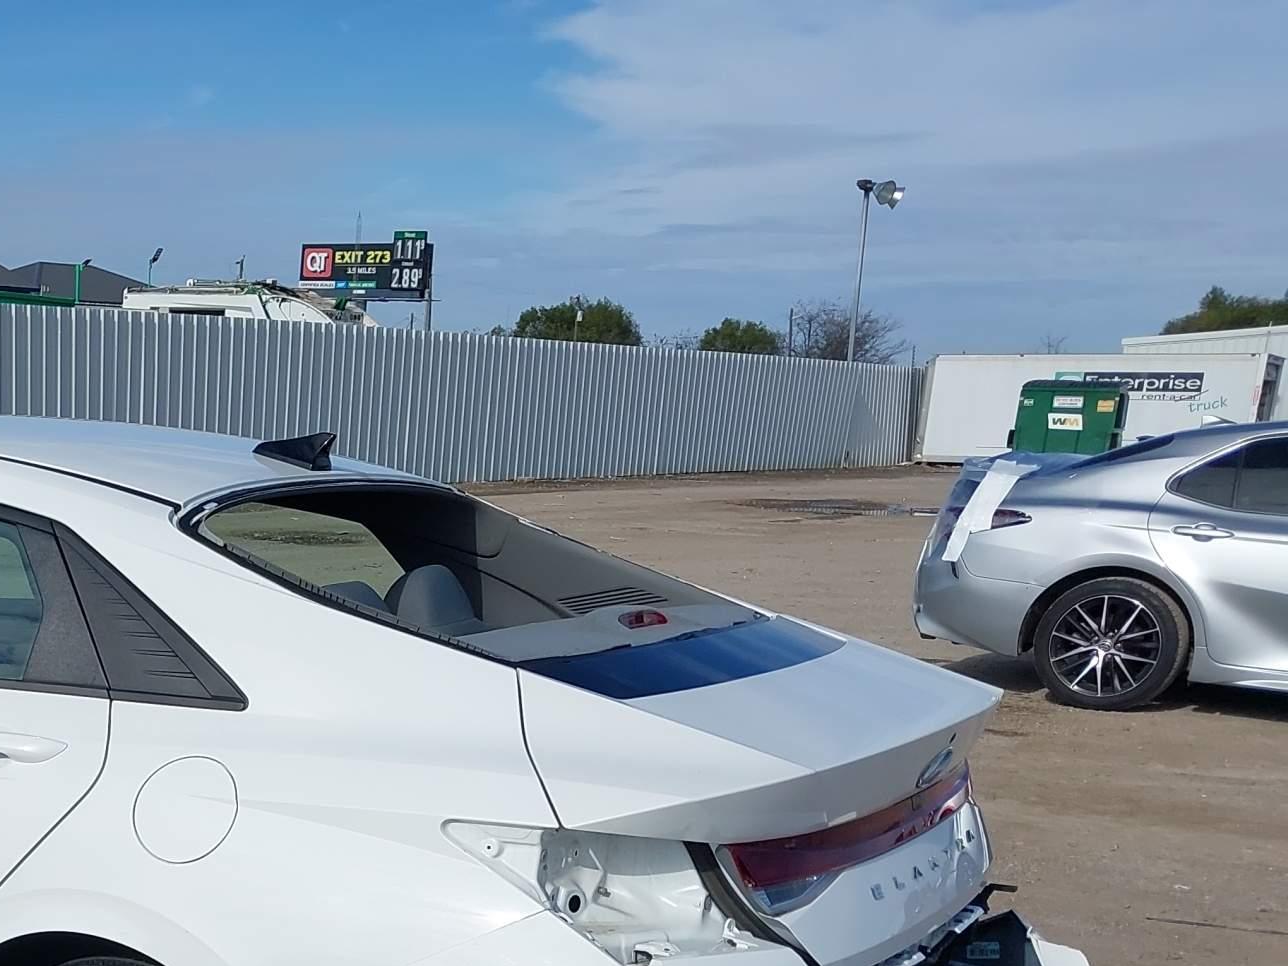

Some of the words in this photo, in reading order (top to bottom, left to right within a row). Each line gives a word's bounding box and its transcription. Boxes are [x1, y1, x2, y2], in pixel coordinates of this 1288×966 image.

[306, 252, 328, 272] QT
[334, 251, 364, 263] EXIT
[366, 251, 391, 263] 273
[1187, 395, 1228, 412] truck
[1052, 417, 1079, 426] WM
